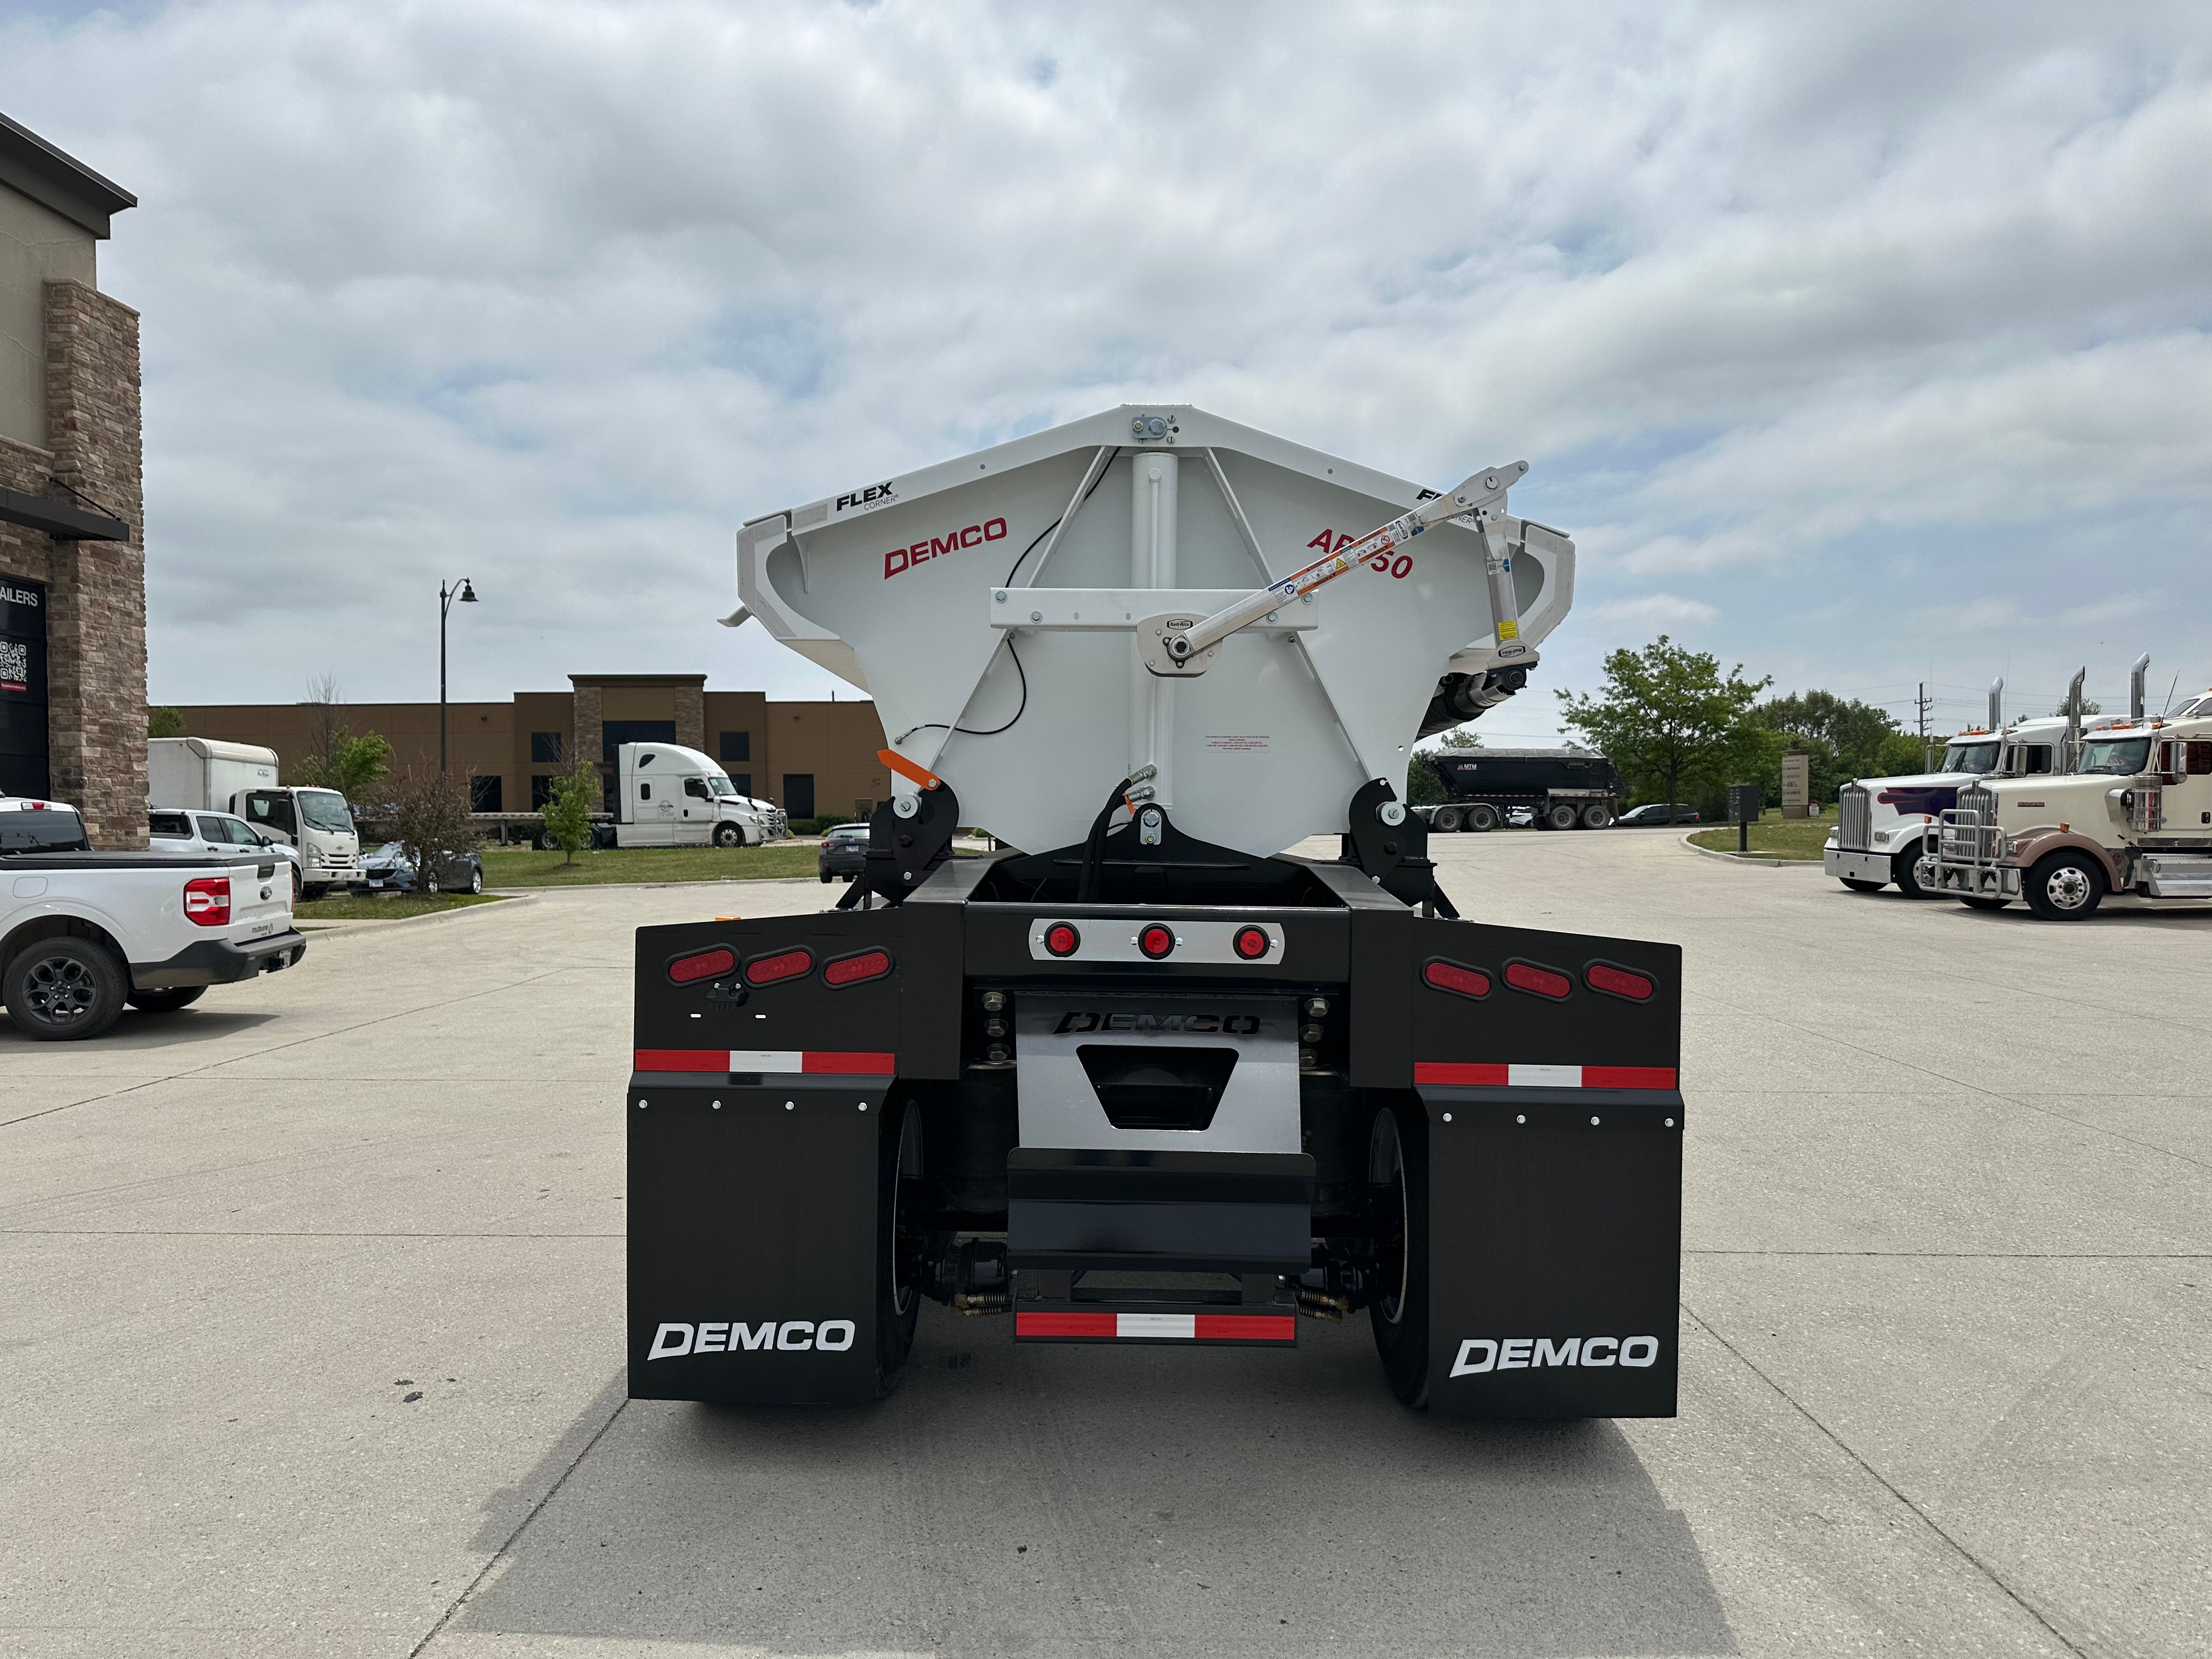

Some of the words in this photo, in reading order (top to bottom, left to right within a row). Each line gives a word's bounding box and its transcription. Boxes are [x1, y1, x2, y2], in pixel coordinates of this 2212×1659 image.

[837, 481, 893, 511] FLEX
[884, 517, 1007, 580] DEMCO
[1052, 1012, 1260, 1035] DEMCO
[647, 1320, 856, 1361] DEMCO
[1449, 1335, 1659, 1378] DEMCO
